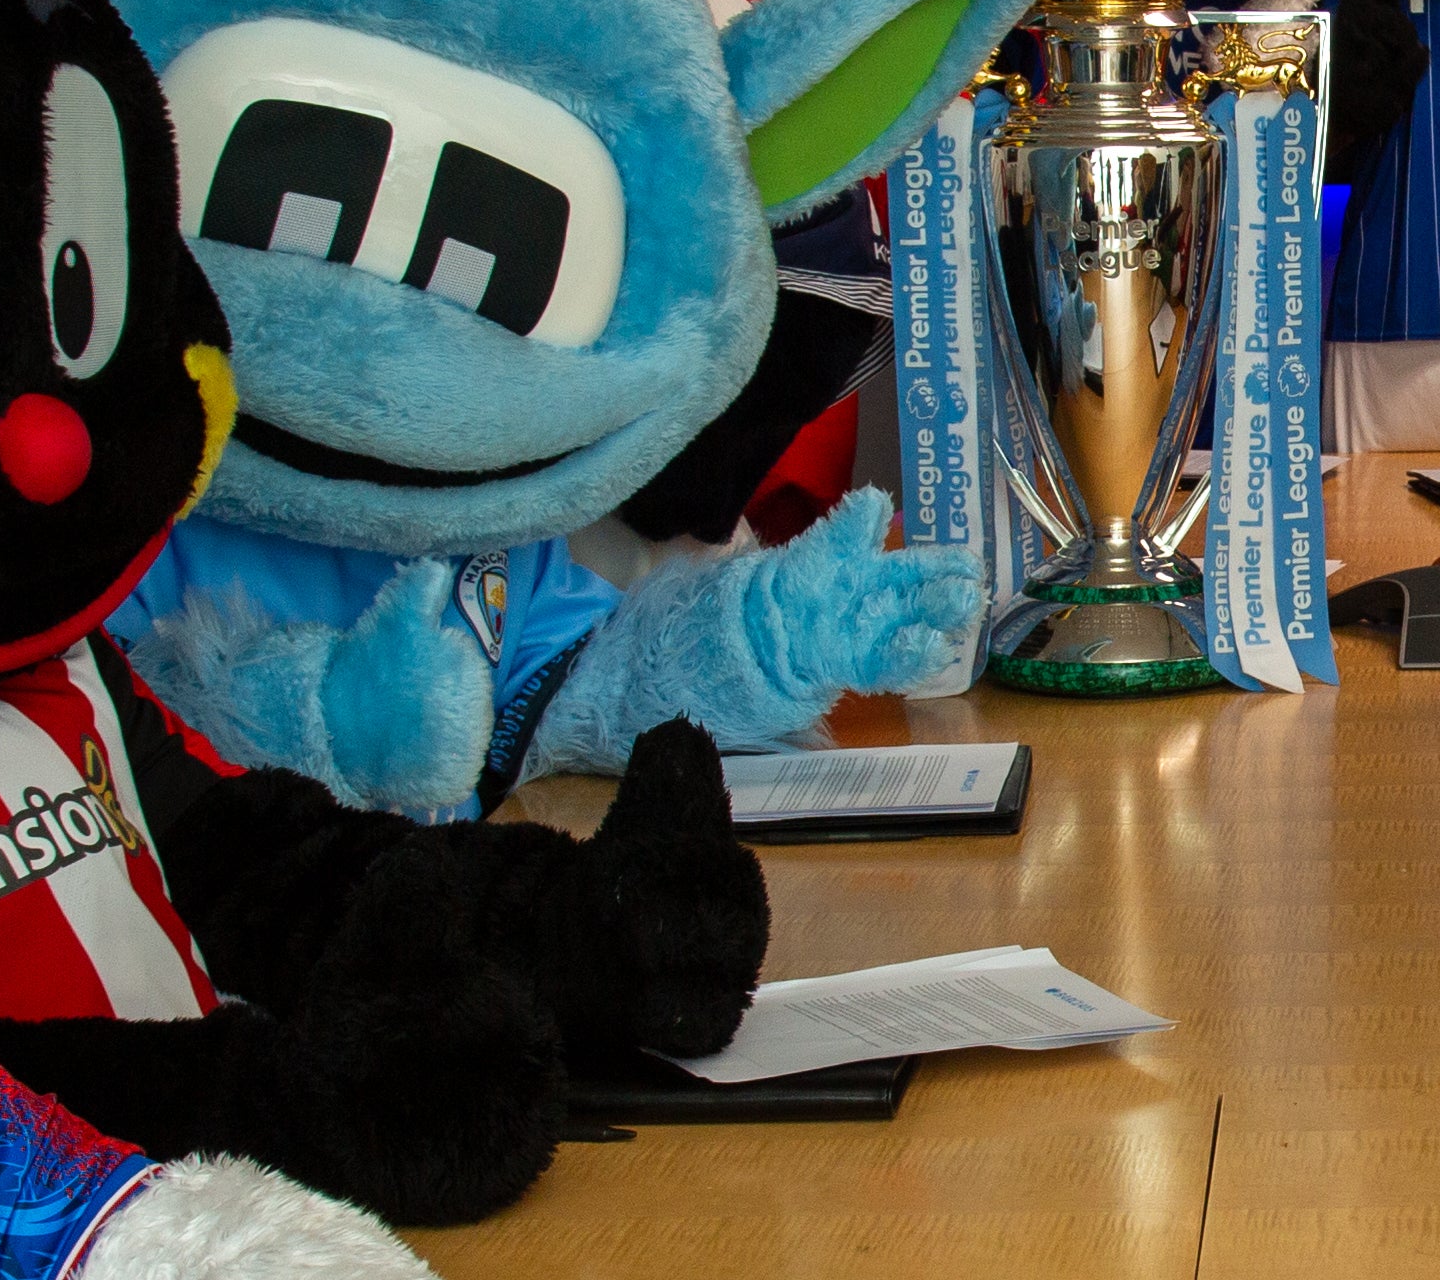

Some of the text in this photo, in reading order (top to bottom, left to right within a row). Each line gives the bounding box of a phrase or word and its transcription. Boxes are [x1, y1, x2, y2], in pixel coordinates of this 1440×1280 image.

[937, 135, 961, 250] League
[1041, 211, 1160, 242] Premier
[1275, 108, 1307, 346] Premier League
[903, 254, 931, 368] Premier
[1046, 245, 1162, 280] League
[1244, 240, 1268, 353] Premier
[912, 428, 942, 542] League
[948, 433, 971, 544] League
[1239, 414, 1272, 647] Premier League
[1282, 405, 1315, 641] Premier League
[1211, 540, 1235, 654] Premier
